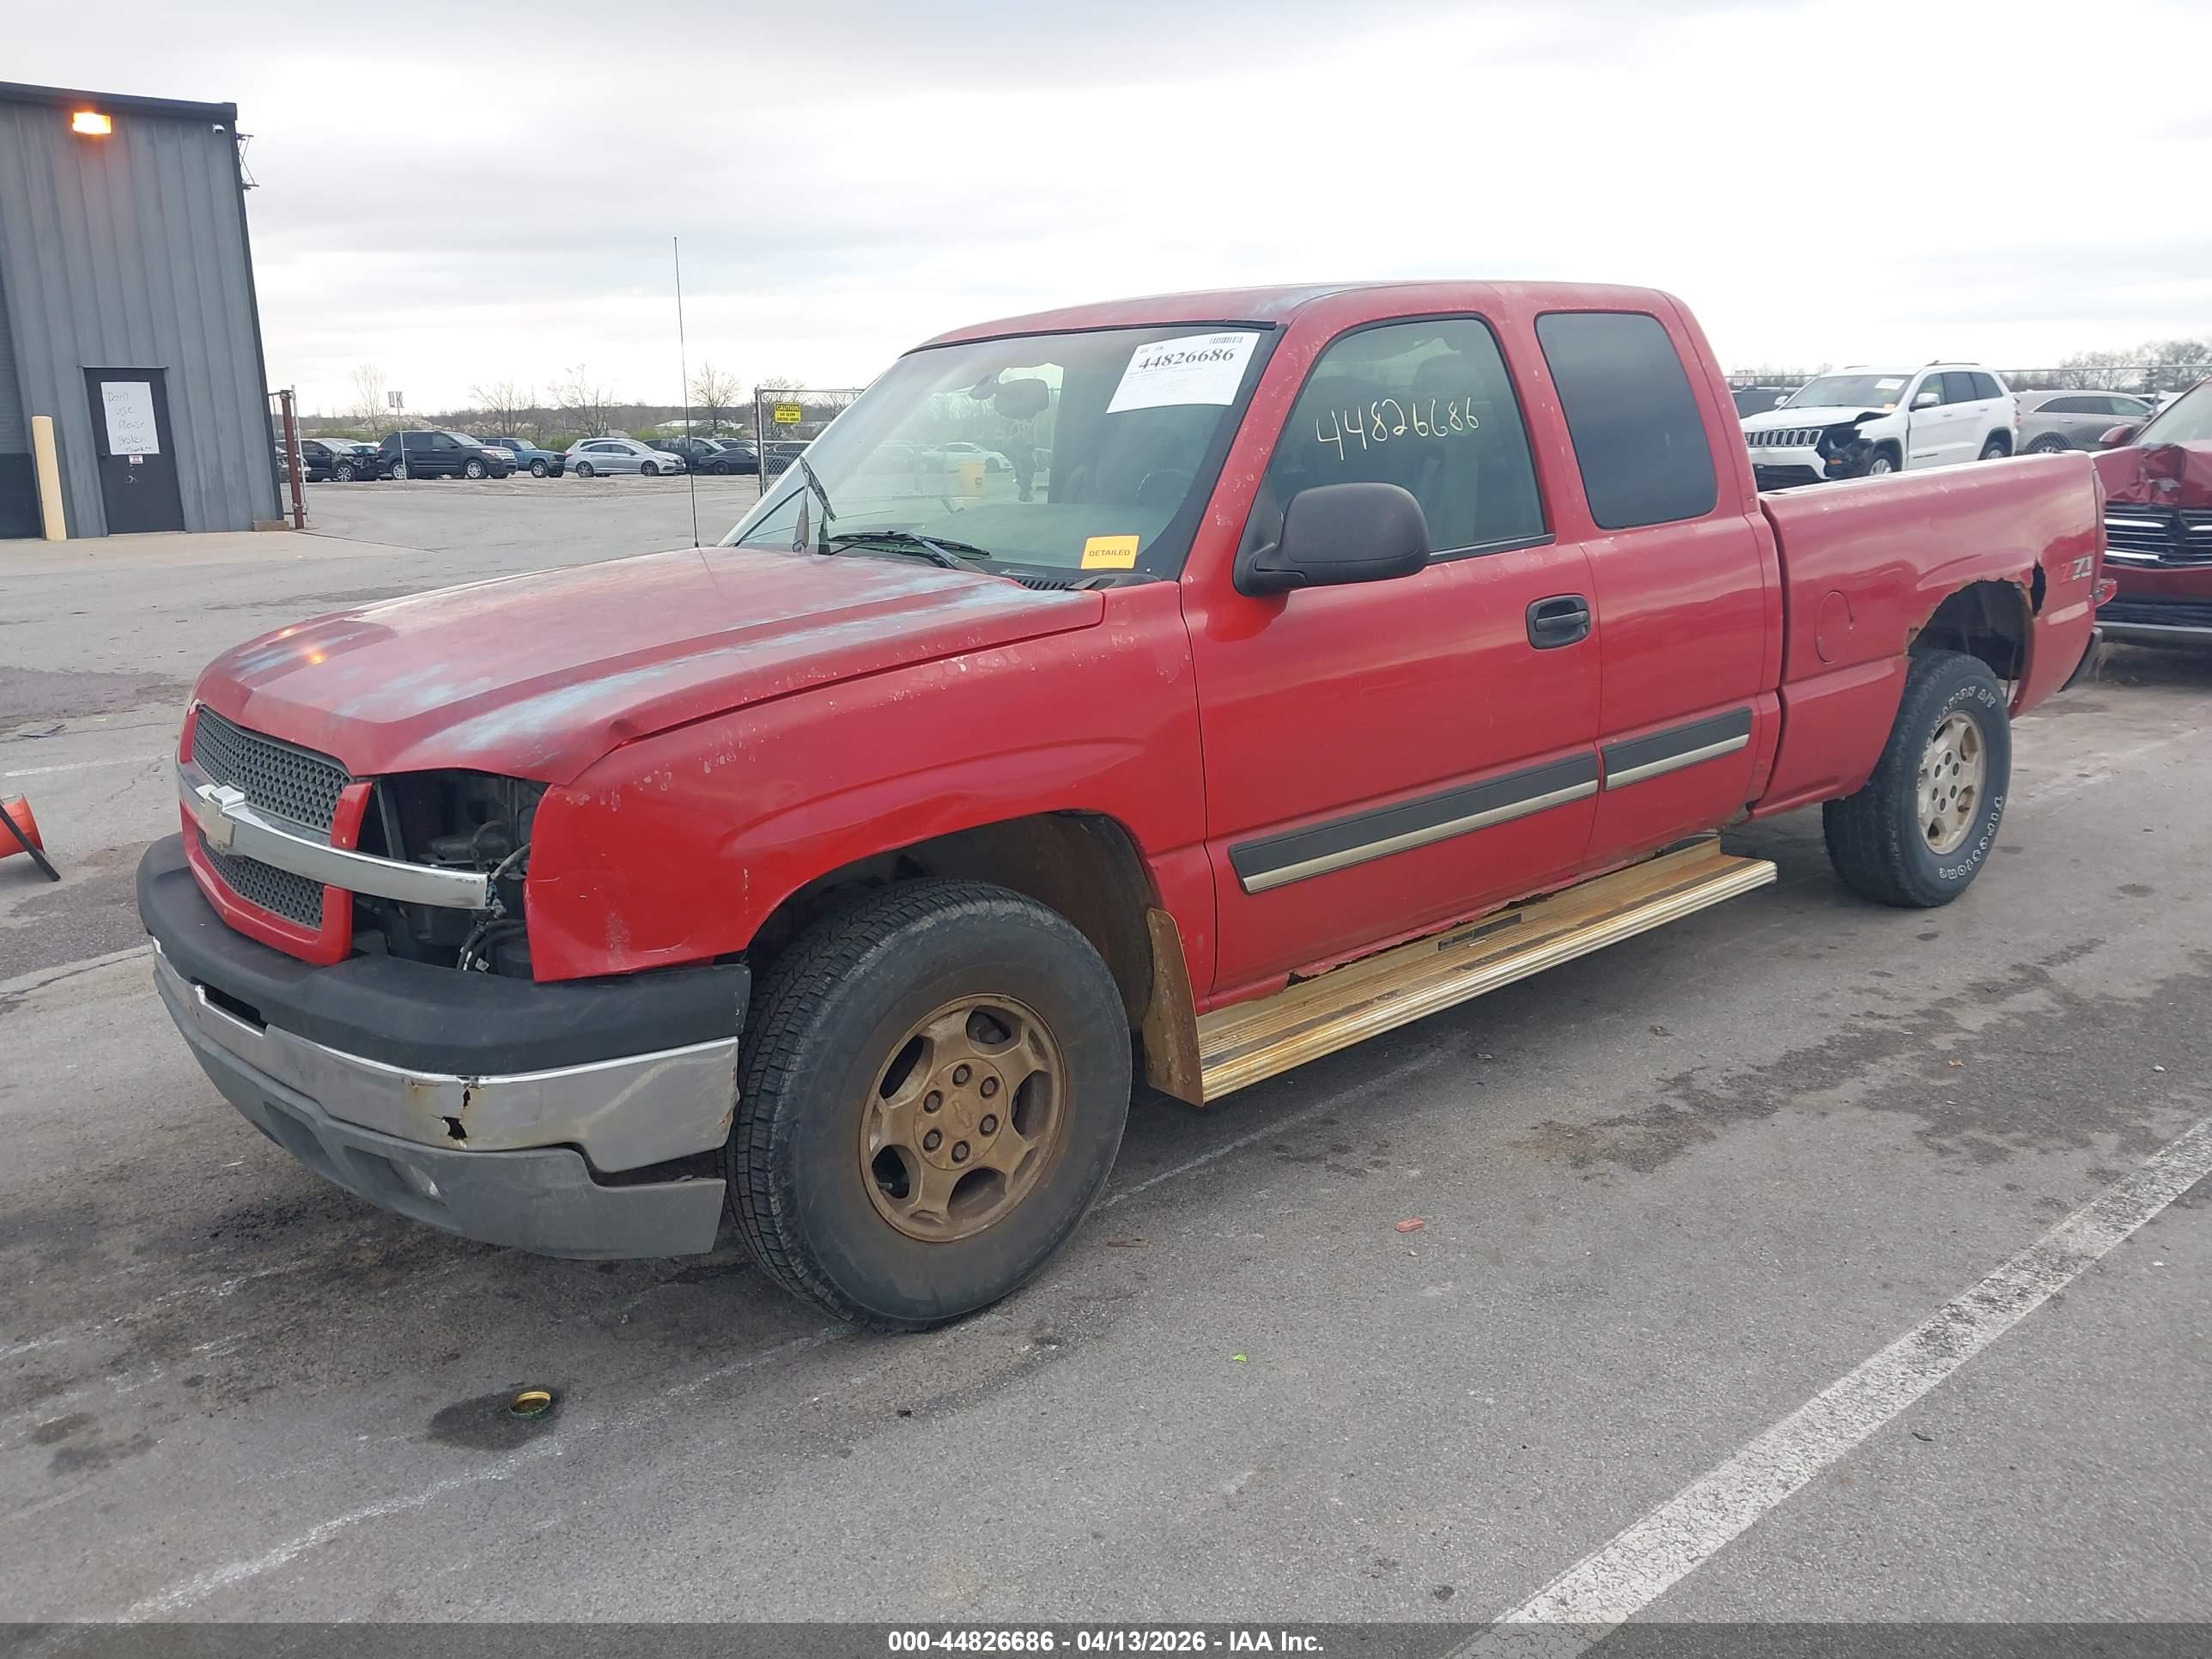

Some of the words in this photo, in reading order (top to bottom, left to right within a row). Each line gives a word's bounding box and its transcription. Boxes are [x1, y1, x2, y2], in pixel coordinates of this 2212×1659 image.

[1139, 348, 1237, 369] 44826686
[1316, 397, 1479, 461] 44826686
[2059, 556, 2093, 583] Z71
